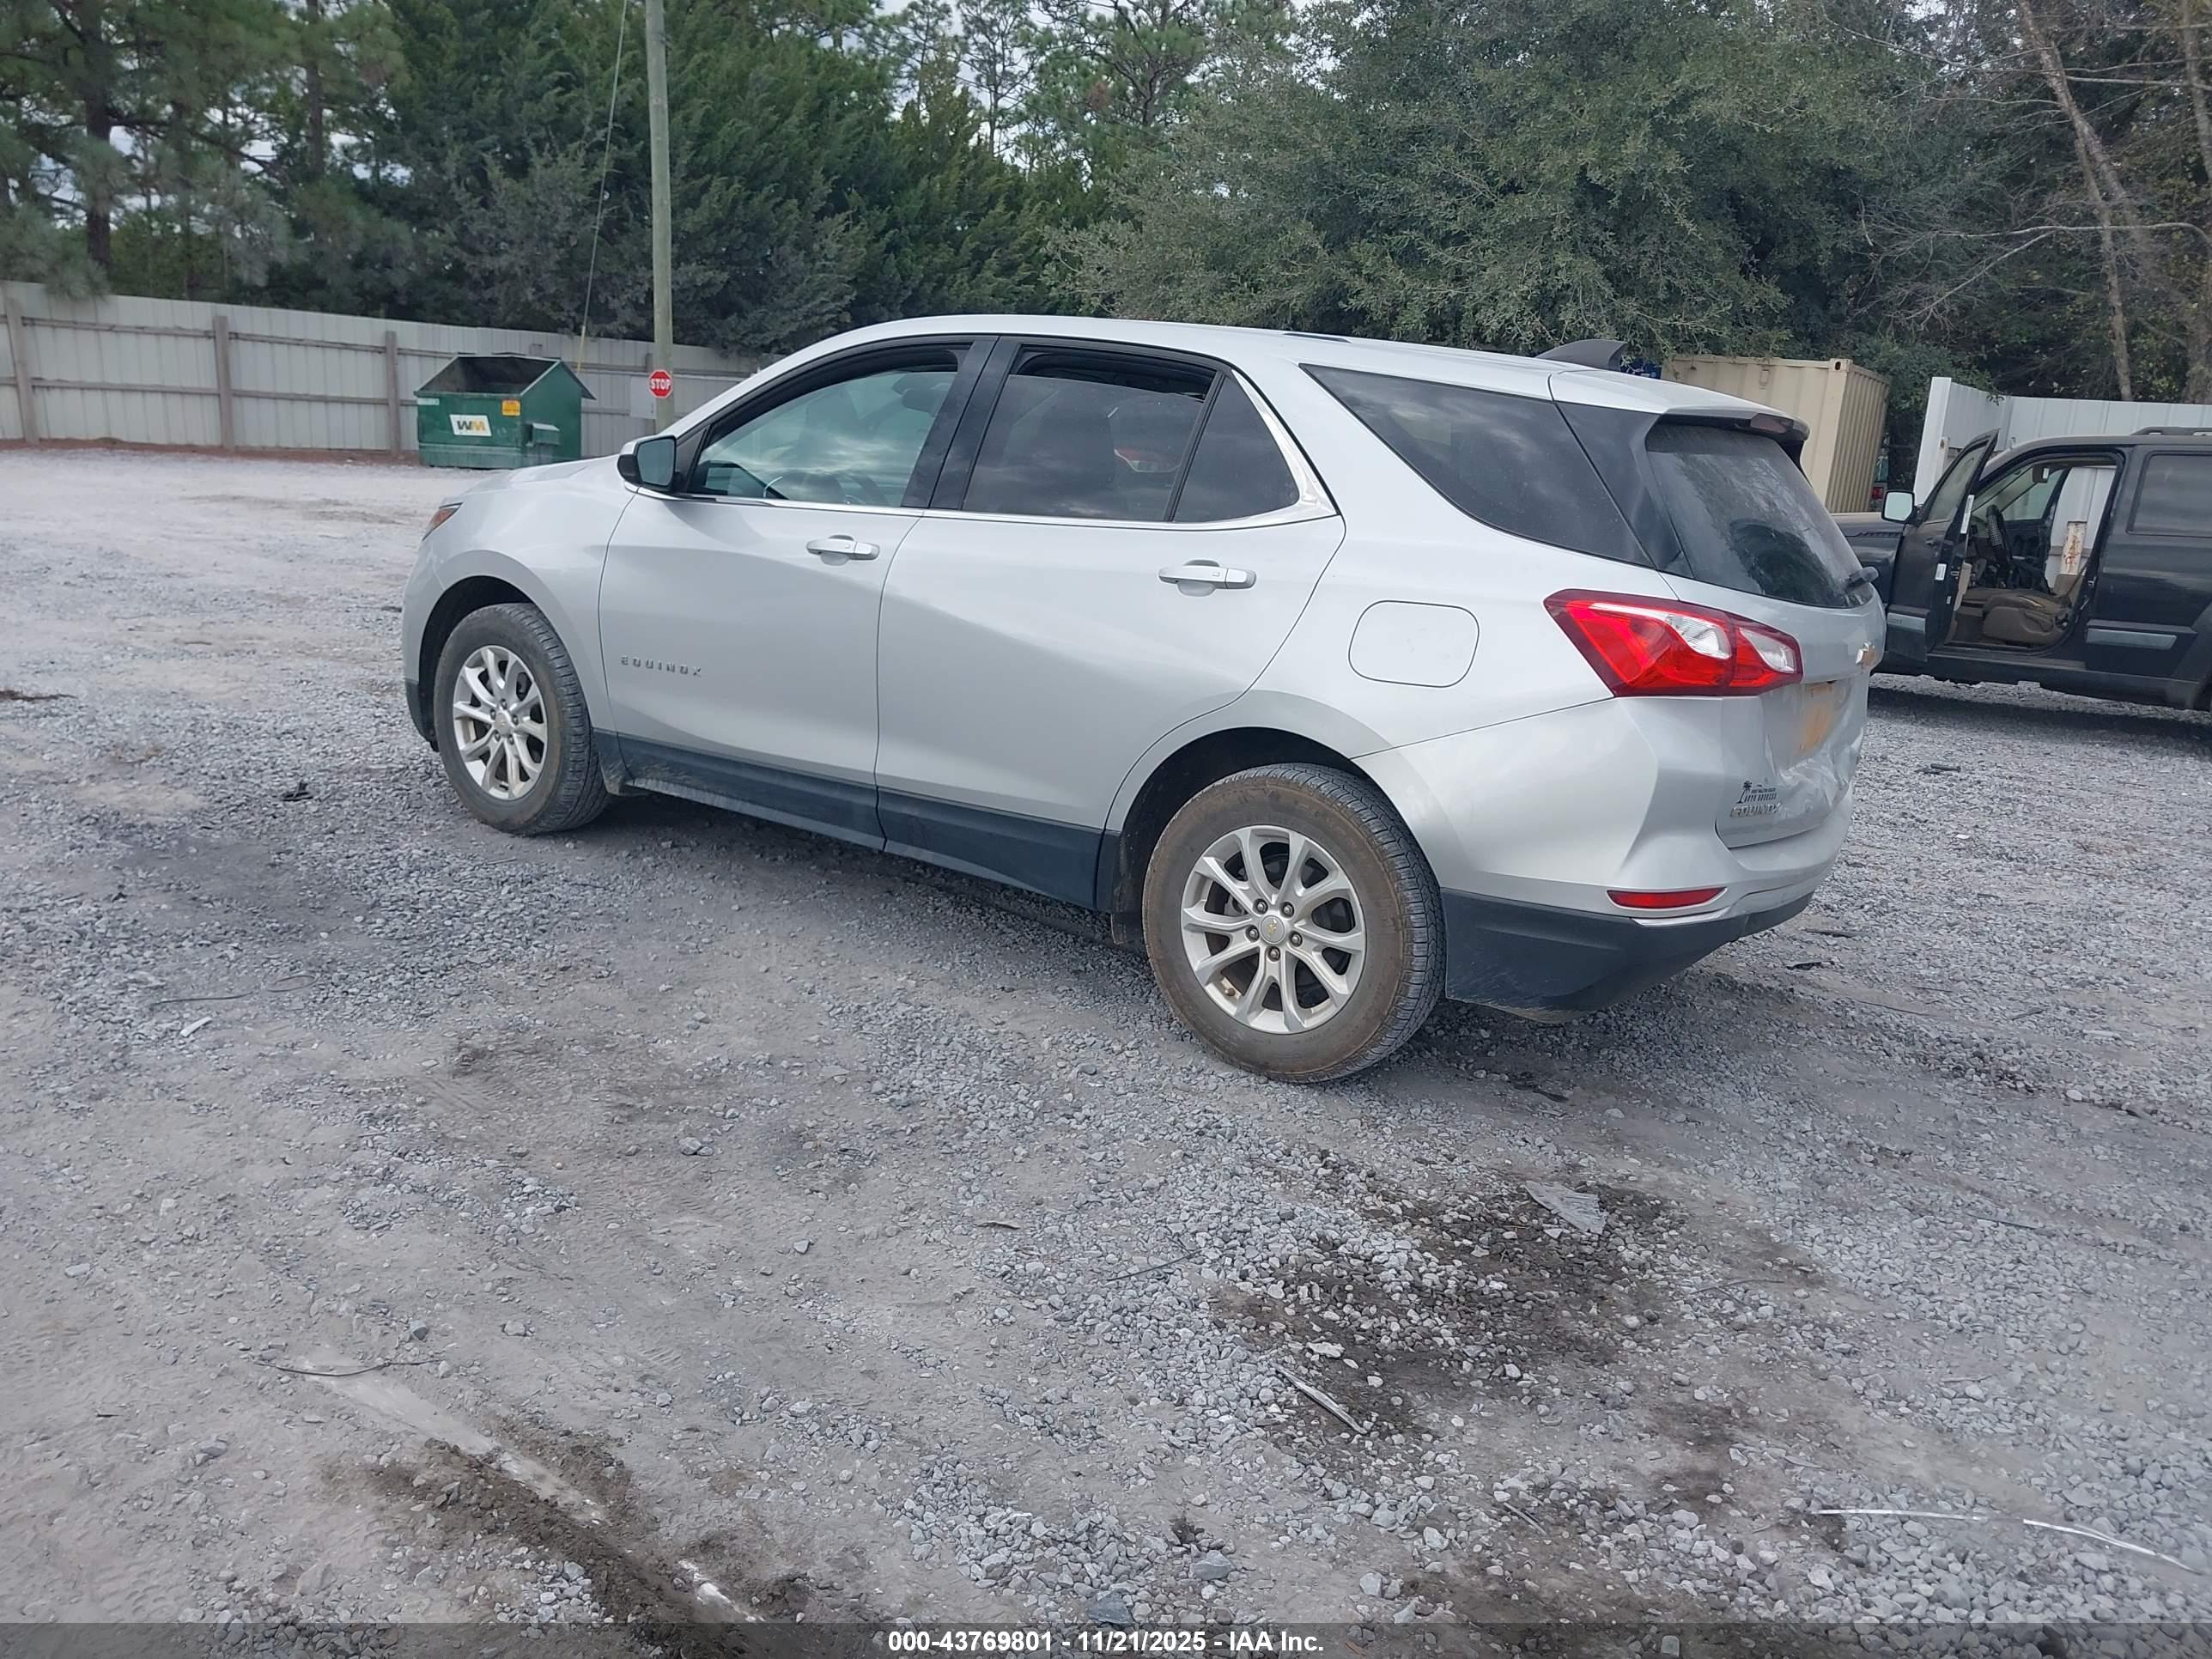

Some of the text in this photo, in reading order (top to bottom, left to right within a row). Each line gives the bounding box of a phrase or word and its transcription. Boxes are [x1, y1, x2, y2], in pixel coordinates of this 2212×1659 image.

[651, 378, 672, 390] STOP
[457, 420, 486, 431] WM
[620, 655, 702, 677] EQUINOX
